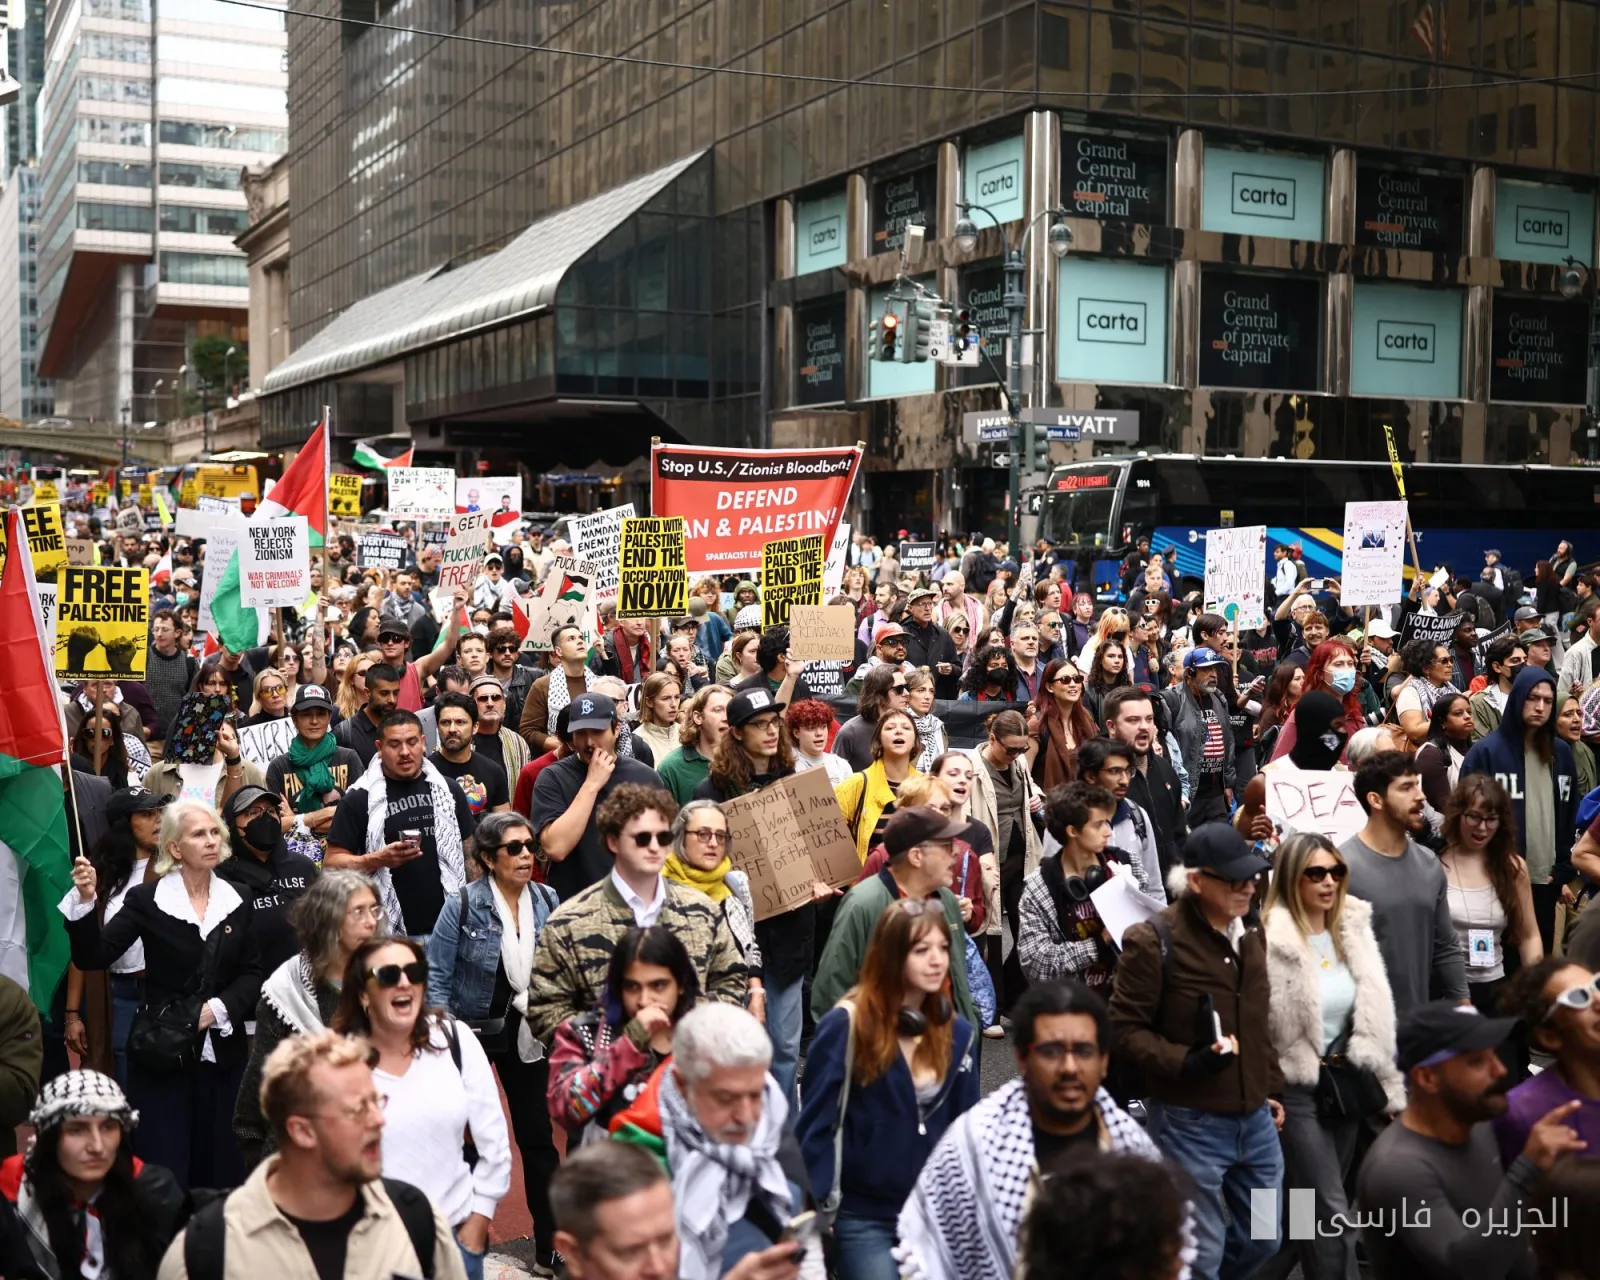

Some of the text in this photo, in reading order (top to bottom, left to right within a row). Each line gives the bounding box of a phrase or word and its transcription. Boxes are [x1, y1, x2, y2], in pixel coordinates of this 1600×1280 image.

[1077, 138, 1127, 160] Grand
[1077, 157, 1136, 180] Central
[980, 172, 1014, 196] carta
[1076, 176, 1096, 194] of
[1378, 174, 1420, 194] Grand
[1240, 186, 1288, 207] carta
[1378, 192, 1428, 212] Central
[1075, 197, 1130, 218] capital
[1377, 209, 1393, 225] of
[813, 228, 837, 245] carta
[1523, 219, 1563, 237] carta
[1377, 229, 1422, 247] capital
[1224, 291, 1269, 310] Grand
[1086, 311, 1138, 331] carta
[1223, 308, 1278, 328] Central
[1509, 312, 1547, 331] Grand
[1223, 326, 1239, 343] of
[1384, 332, 1428, 351] carta
[1509, 329, 1554, 348] Central
[1222, 345, 1271, 367] capital
[1508, 346, 1523, 360] of
[1508, 363, 1549, 382] capital
[1058, 415, 1118, 434] HYATT
[1064, 429, 1079, 438] Ave
[661, 459, 695, 476] Stop
[335, 475, 357, 488] FREE
[717, 487, 797, 510] DEFEND
[458, 514, 484, 532] GET
[615, 508, 633, 521] BRO
[249, 526, 297, 539] NEW YORK
[625, 518, 683, 534] STAND WITH
[684, 519, 710, 539] AN
[716, 517, 731, 537] &
[254, 538, 293, 550] REJECTS
[358, 536, 408, 549] EVERYTHING
[578, 537, 610, 552] ENEMY
[624, 532, 684, 549] PALESTINE!
[765, 535, 822, 556] STAND WITH
[255, 549, 293, 561] ZIONISM
[363, 547, 401, 558] HAS BEEN
[623, 548, 657, 568] END
[661, 546, 684, 567] THE
[705, 551, 748, 561] SPARTACIST
[765, 549, 822, 569] PALESTINE!
[248, 569, 303, 581] WAR CRIMINALS
[554, 556, 576, 572] FUCK
[579, 560, 597, 576] BIBI
[765, 561, 822, 588] END THE
[65, 568, 142, 604] FREE
[251, 579, 301, 589] NOT WELCOME
[622, 569, 686, 584] OCCUPATION
[621, 581, 685, 610] NOW!
[764, 580, 821, 602] OCCUPATION
[59, 603, 147, 623] PALESTINE
[792, 608, 827, 627] WAR
[1408, 614, 1430, 628] YOU
[801, 671, 840, 684] COVERUP
[726, 787, 797, 818] etanyahu
[732, 795, 837, 841] ost Wanted Man
[774, 853, 787, 871] of
